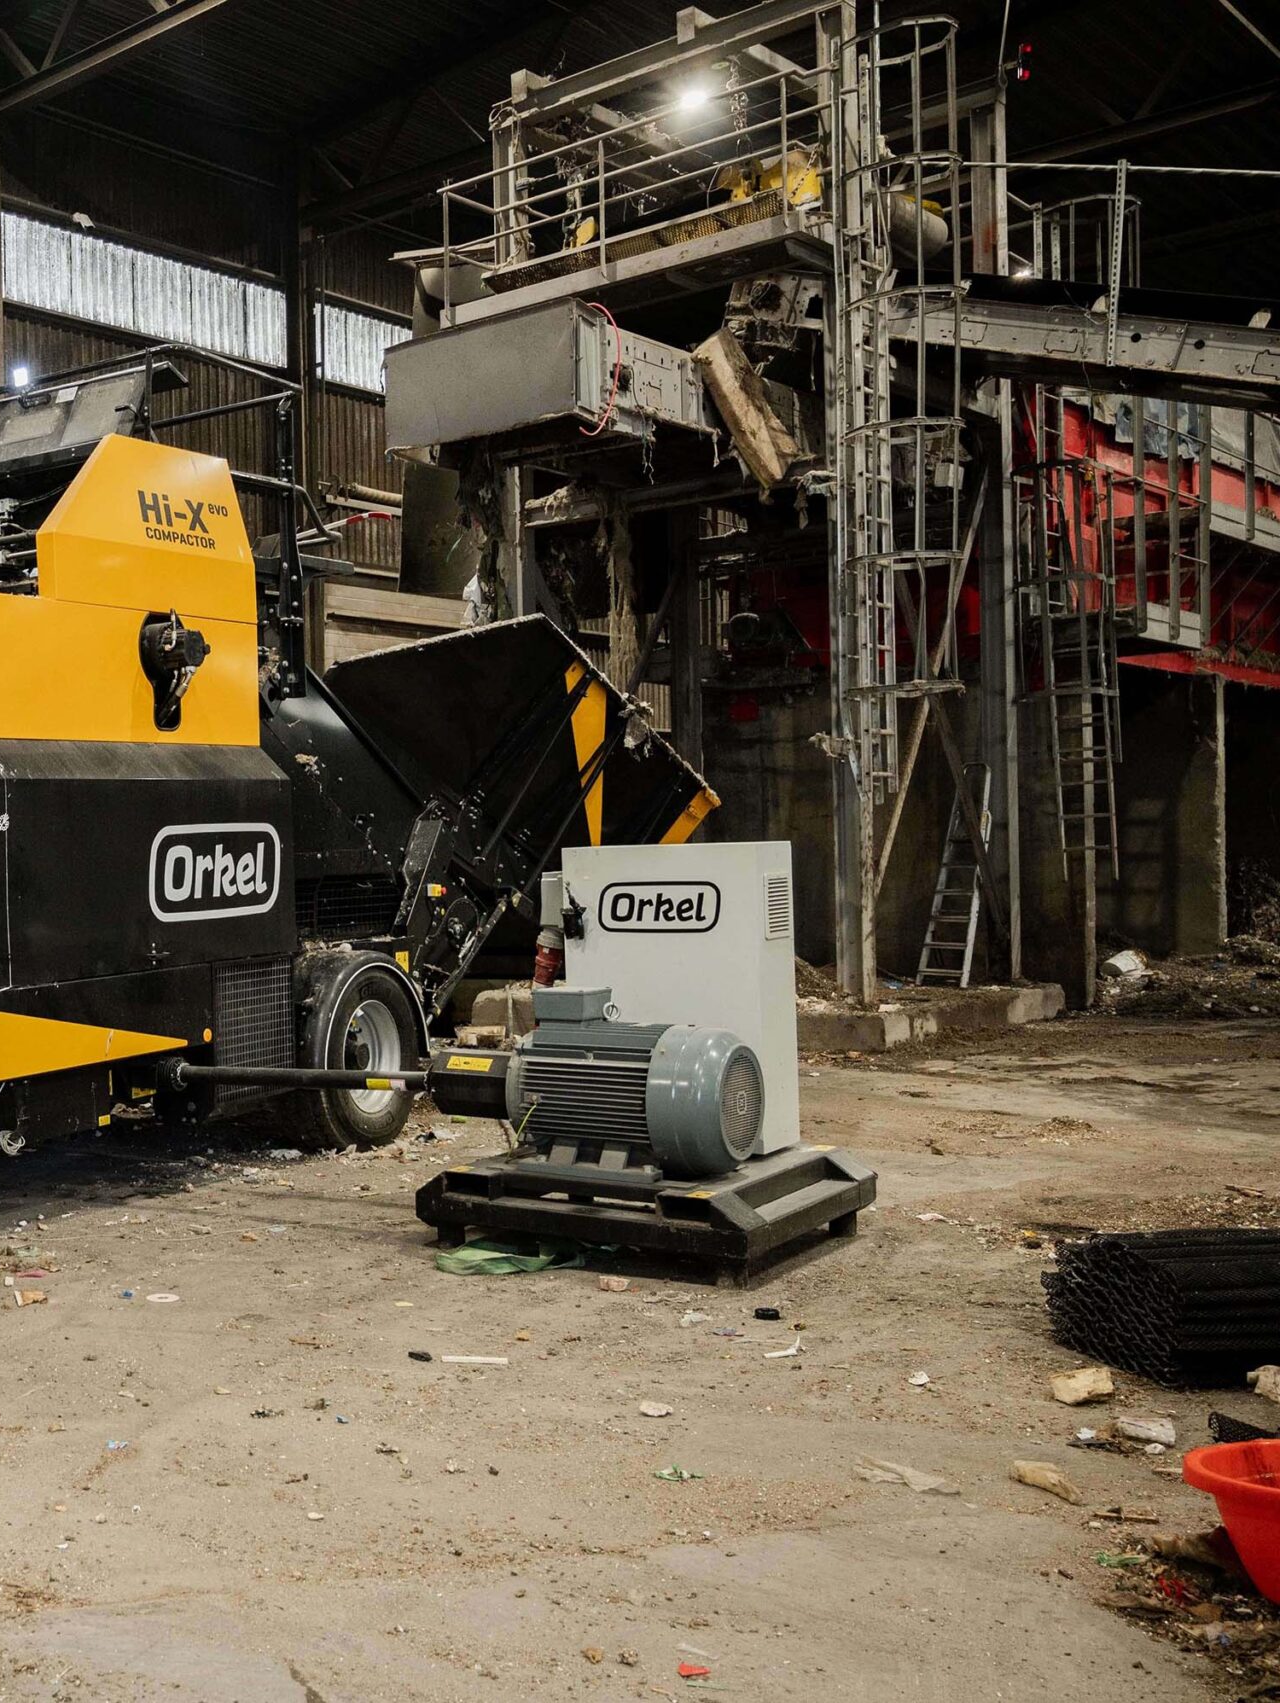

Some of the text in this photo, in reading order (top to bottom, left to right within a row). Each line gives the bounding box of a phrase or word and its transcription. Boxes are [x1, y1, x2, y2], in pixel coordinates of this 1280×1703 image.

[138, 490, 228, 534] Hi-X evo
[145, 527, 216, 550] COMPACTOR
[164, 842, 268, 901] Orkel
[611, 892, 707, 922] Orkel
